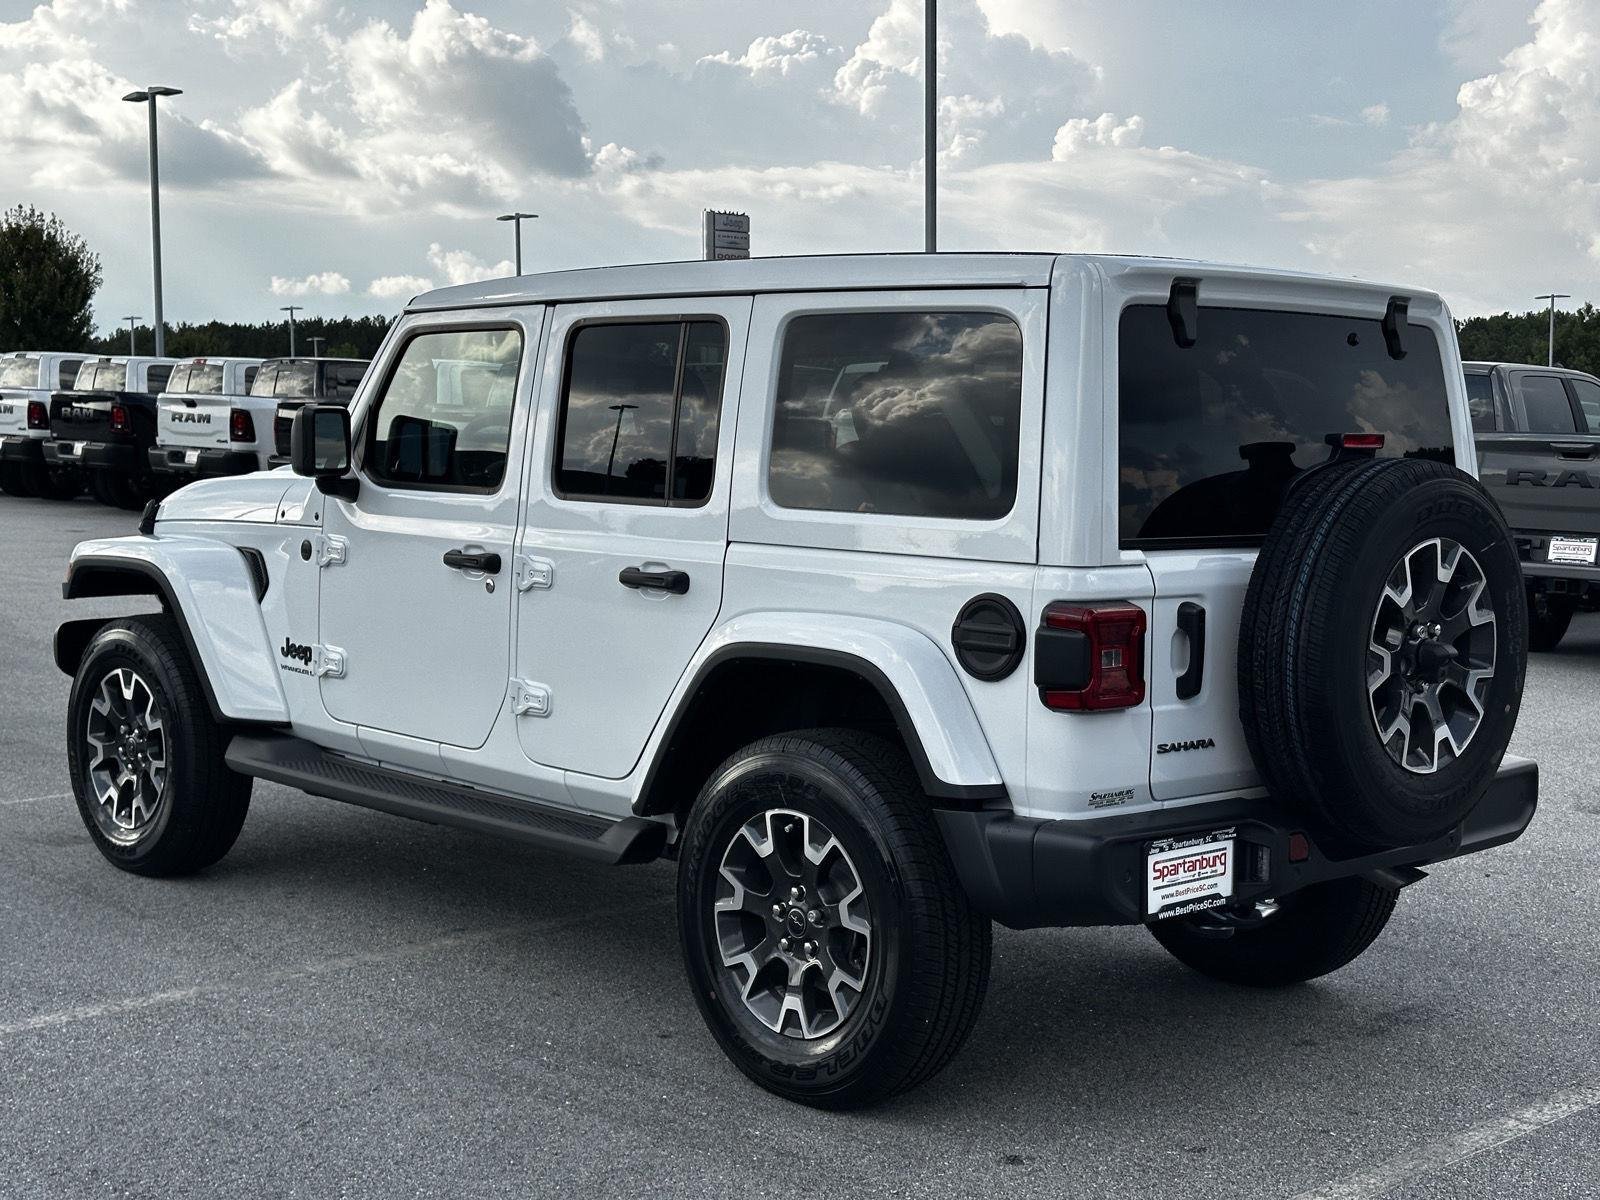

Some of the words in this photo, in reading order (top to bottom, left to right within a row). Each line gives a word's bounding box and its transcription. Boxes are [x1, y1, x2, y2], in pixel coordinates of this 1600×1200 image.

[61, 407, 94, 418] RAM
[171, 412, 211, 424] RAM
[1505, 467, 1600, 489] RA
[281, 637, 312, 666] Jeep
[281, 664, 310, 676] WRANGLER
[1157, 738, 1215, 754] SAHARA
[1152, 852, 1227, 882] Spartanburg
[1160, 882, 1218, 900] www.BestPriceSC.com
[1158, 897, 1226, 920] www.BestPriceSC.com
